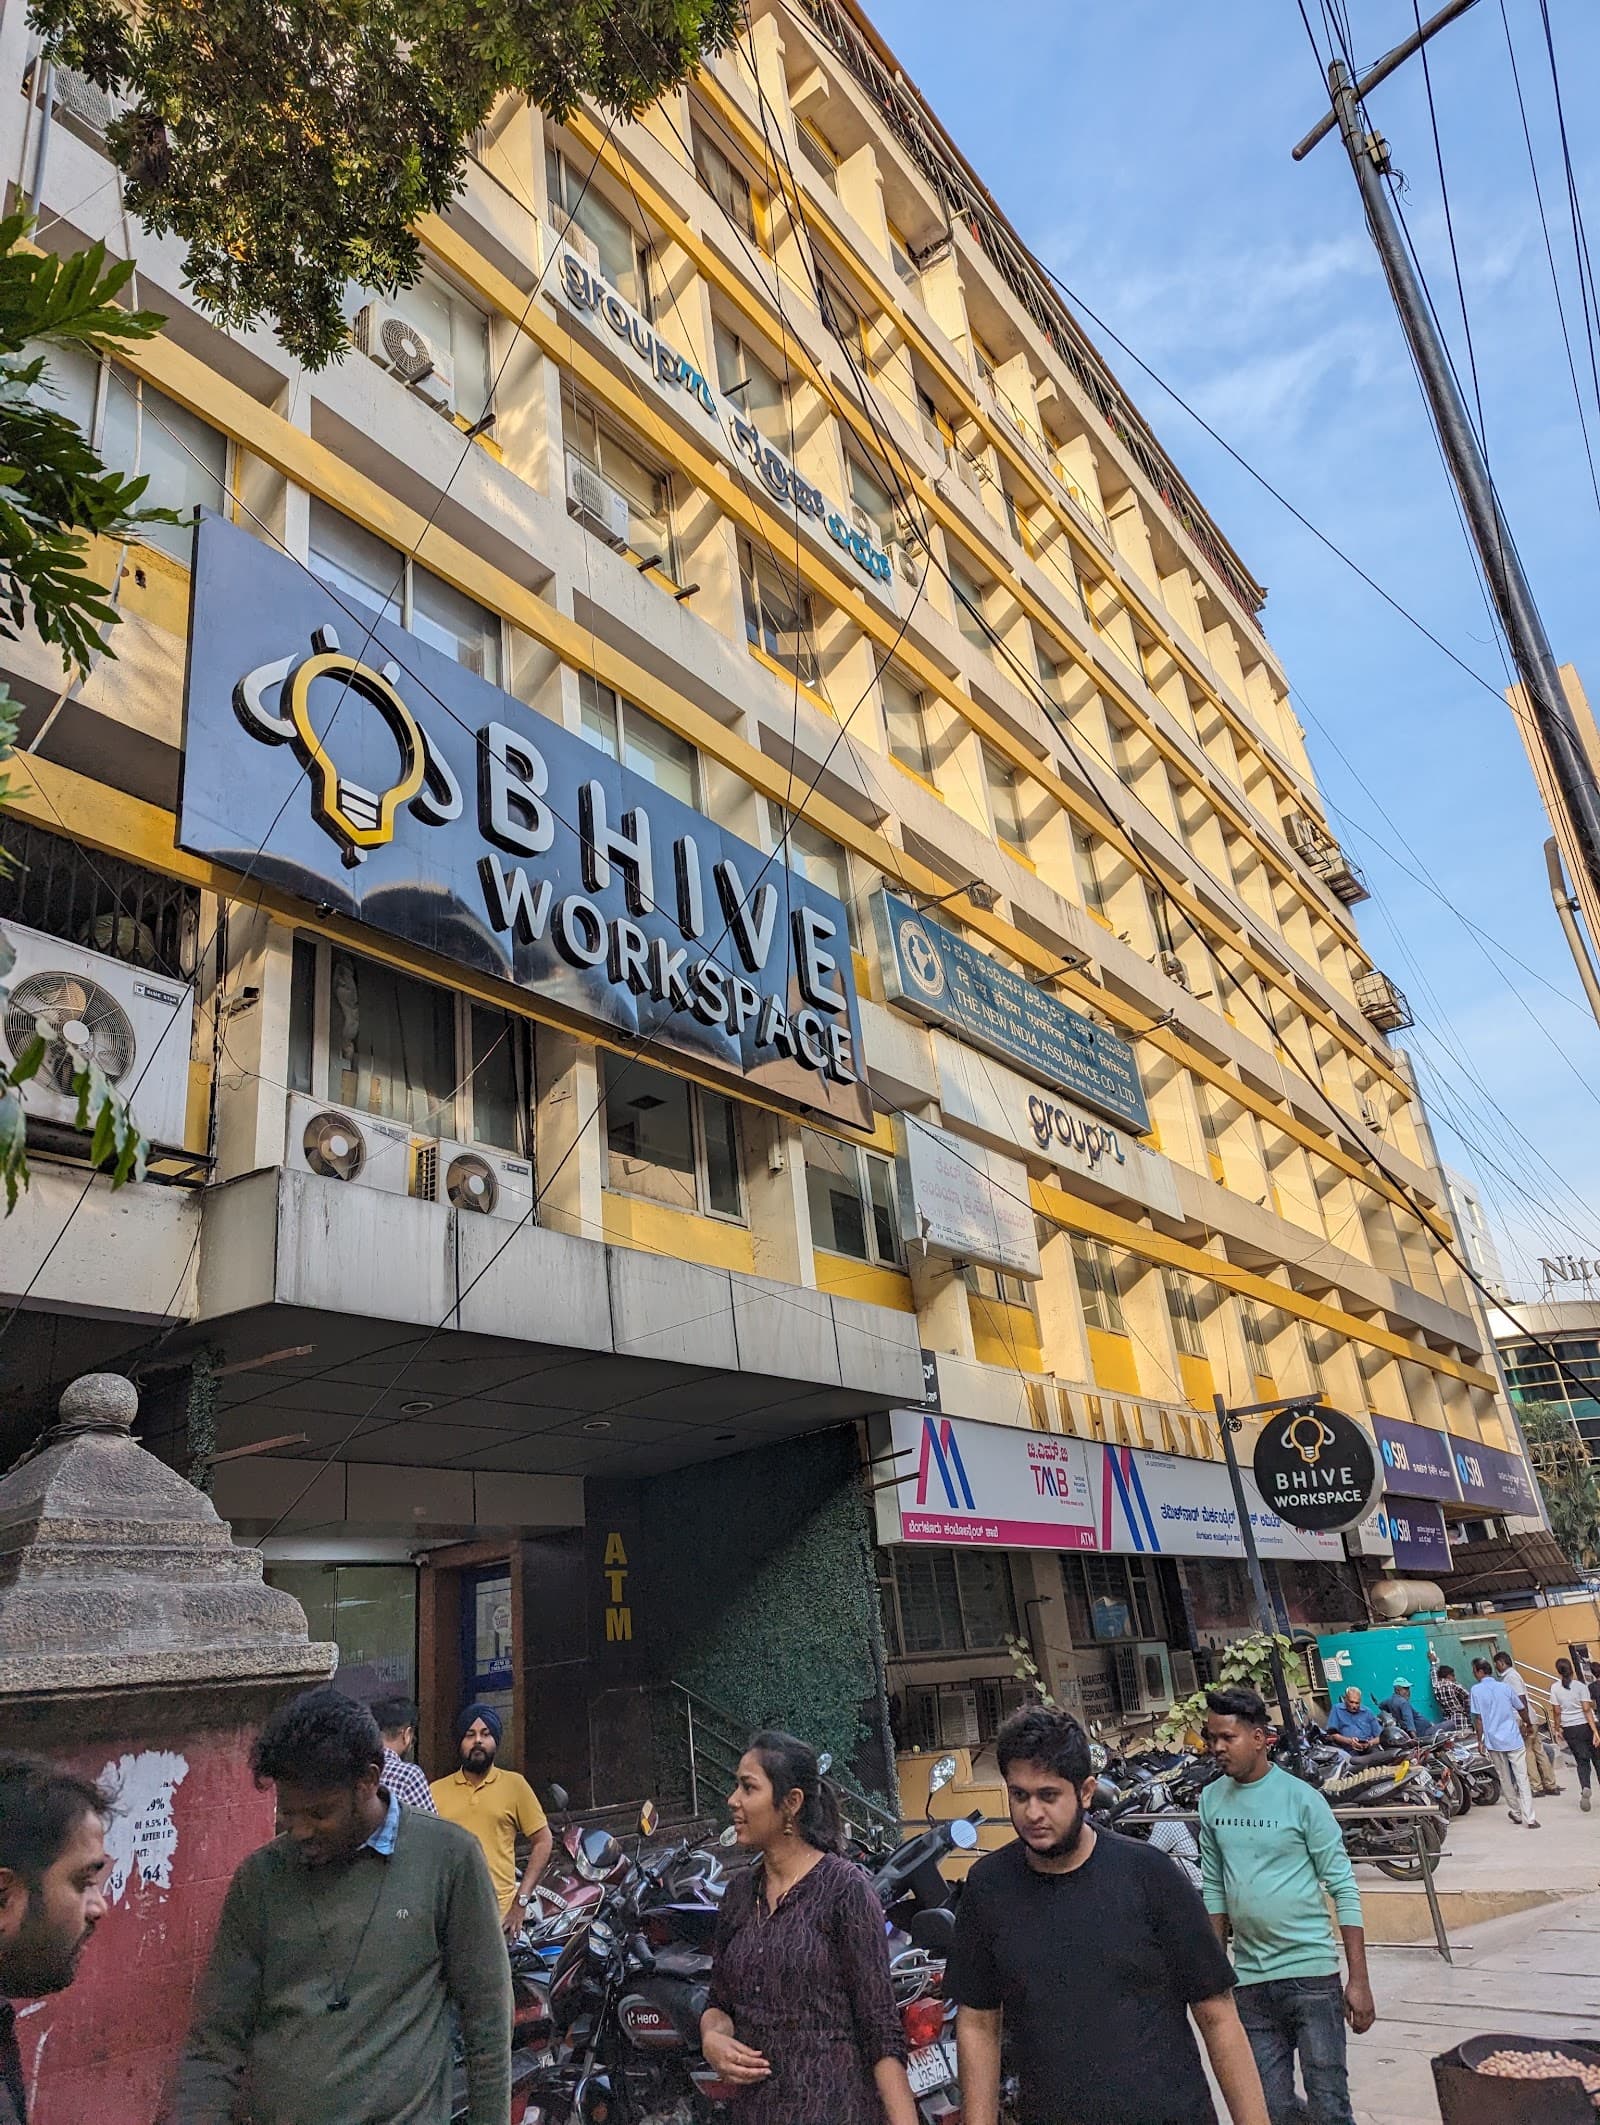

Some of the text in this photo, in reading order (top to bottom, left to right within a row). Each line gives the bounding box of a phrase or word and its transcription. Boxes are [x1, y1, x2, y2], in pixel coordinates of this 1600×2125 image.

[559, 254, 716, 414] groupm
[477, 721, 847, 1012] BHIVE
[478, 853, 858, 1086] WORKSPACE
[954, 987, 981, 1015] THE
[981, 1001, 1007, 1030] NEW
[1009, 1020, 1040, 1050] INDIA
[1041, 1039, 1101, 1085] ASSURANCE
[1026, 1095, 1125, 1170] groupm
[1391, 1441, 1410, 1471] SBI
[1464, 1456, 1485, 1488] SBI
[1030, 1465, 1069, 1497] TMB
[1275, 1465, 1354, 1490] BHIVE
[1274, 1490, 1362, 1508] WORKSPACE
[1080, 1531, 1095, 1546] ATM
[1397, 1518, 1412, 1542] SBI
[604, 1533, 632, 1641] ATM
[141, 1832, 161, 1842] AFTER
[1215, 1818, 1279, 1829] WANDERLUST
